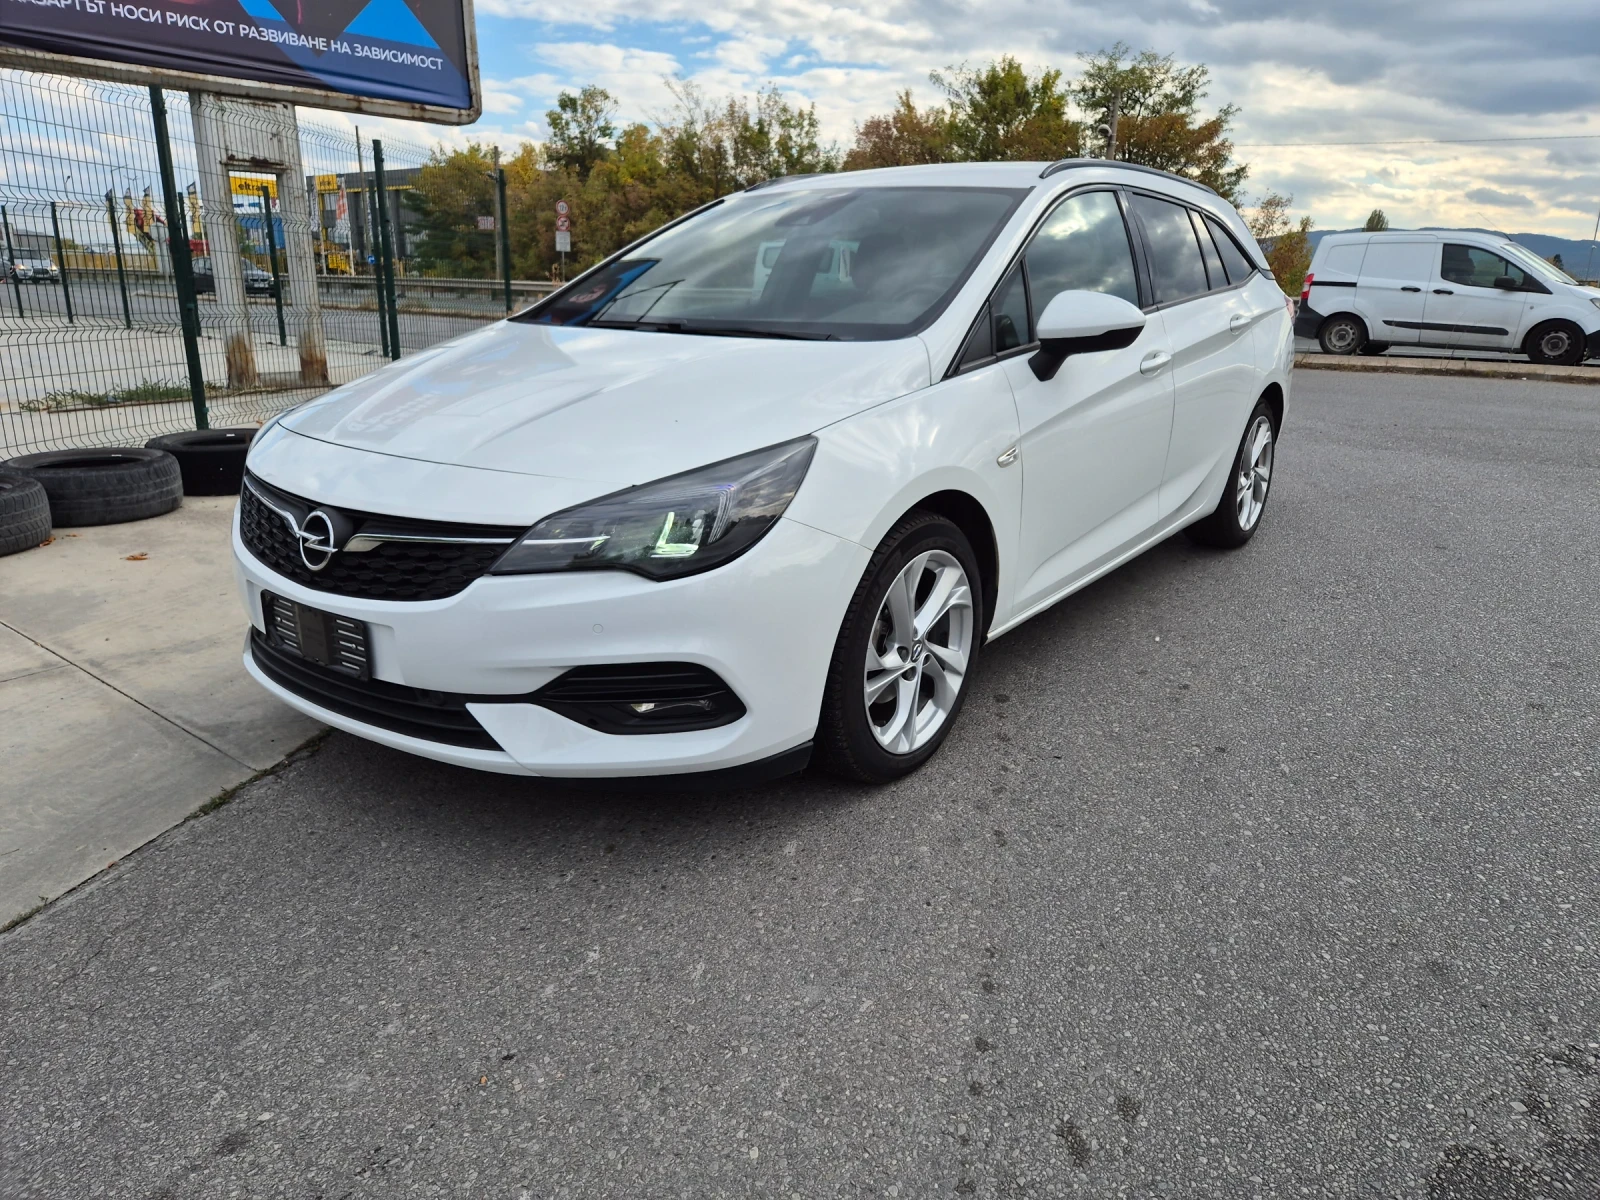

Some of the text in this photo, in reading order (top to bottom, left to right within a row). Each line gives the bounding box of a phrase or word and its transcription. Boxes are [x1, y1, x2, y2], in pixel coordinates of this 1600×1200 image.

[9, 0, 444, 71] АРТЪТ НОСИ РИСК ОТ РАЗВИВАНЕ НА ЗАВИСИМОСТ
